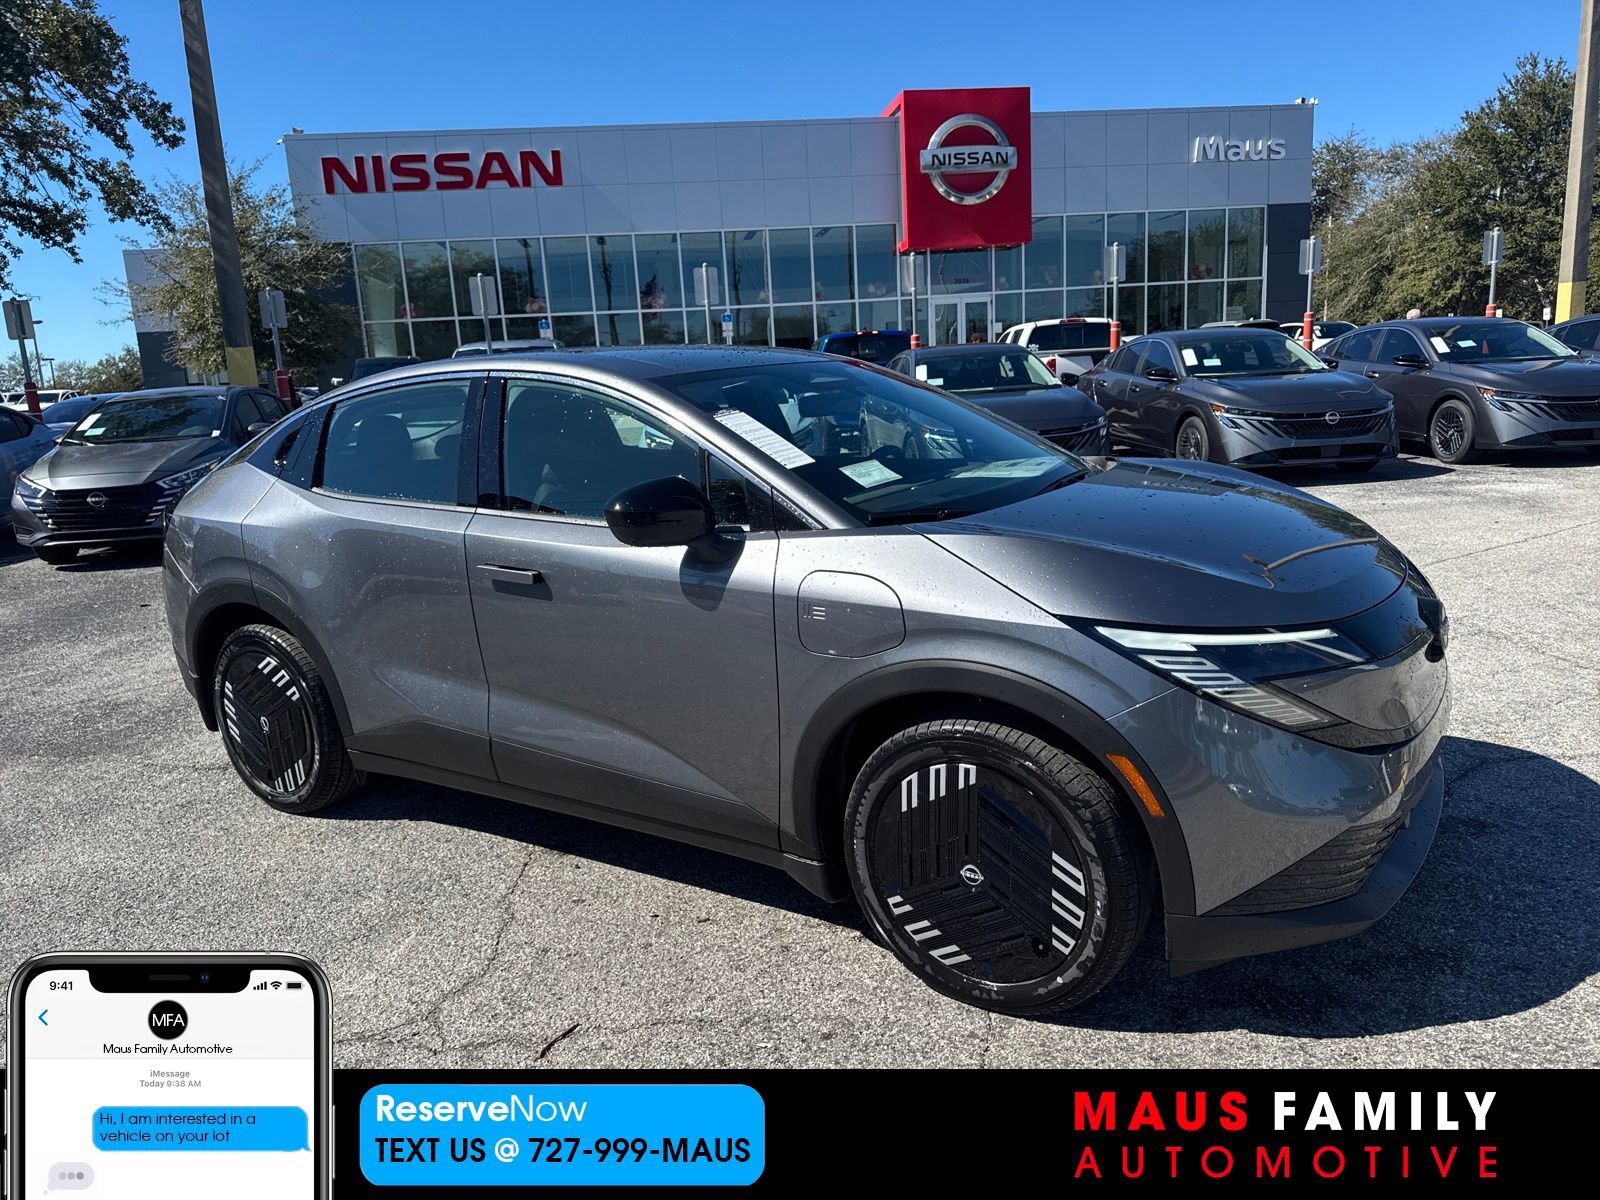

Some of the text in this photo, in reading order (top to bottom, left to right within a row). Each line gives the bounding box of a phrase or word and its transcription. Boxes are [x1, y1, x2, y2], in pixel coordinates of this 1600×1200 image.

[931, 151, 1009, 167] NISSAN
[1193, 135, 1287, 163] Maus
[321, 149, 563, 194] NISSAN
